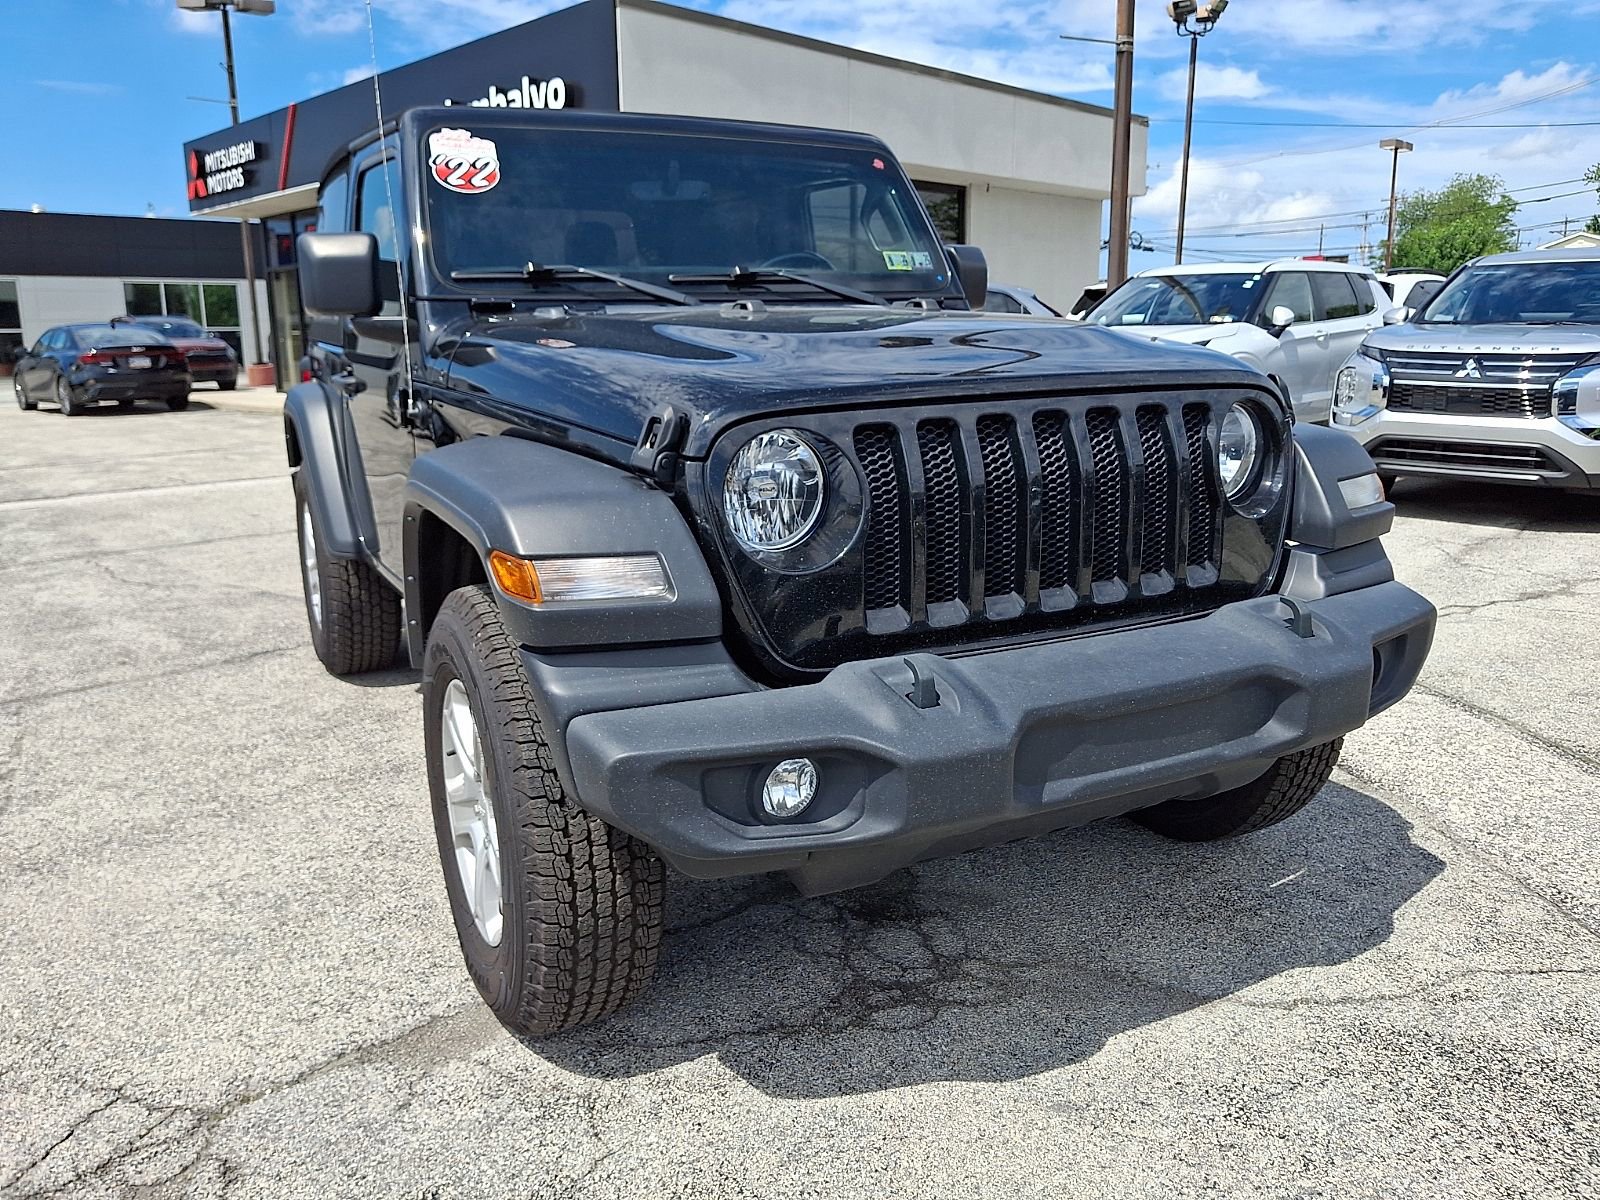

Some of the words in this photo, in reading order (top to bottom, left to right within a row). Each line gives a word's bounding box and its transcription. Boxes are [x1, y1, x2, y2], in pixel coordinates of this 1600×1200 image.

[204, 140, 256, 173] MITSUBISHI
[432, 153, 498, 187] '22
[206, 166, 245, 195] MOTORS
[1406, 344, 1560, 352] OUTLANDER
